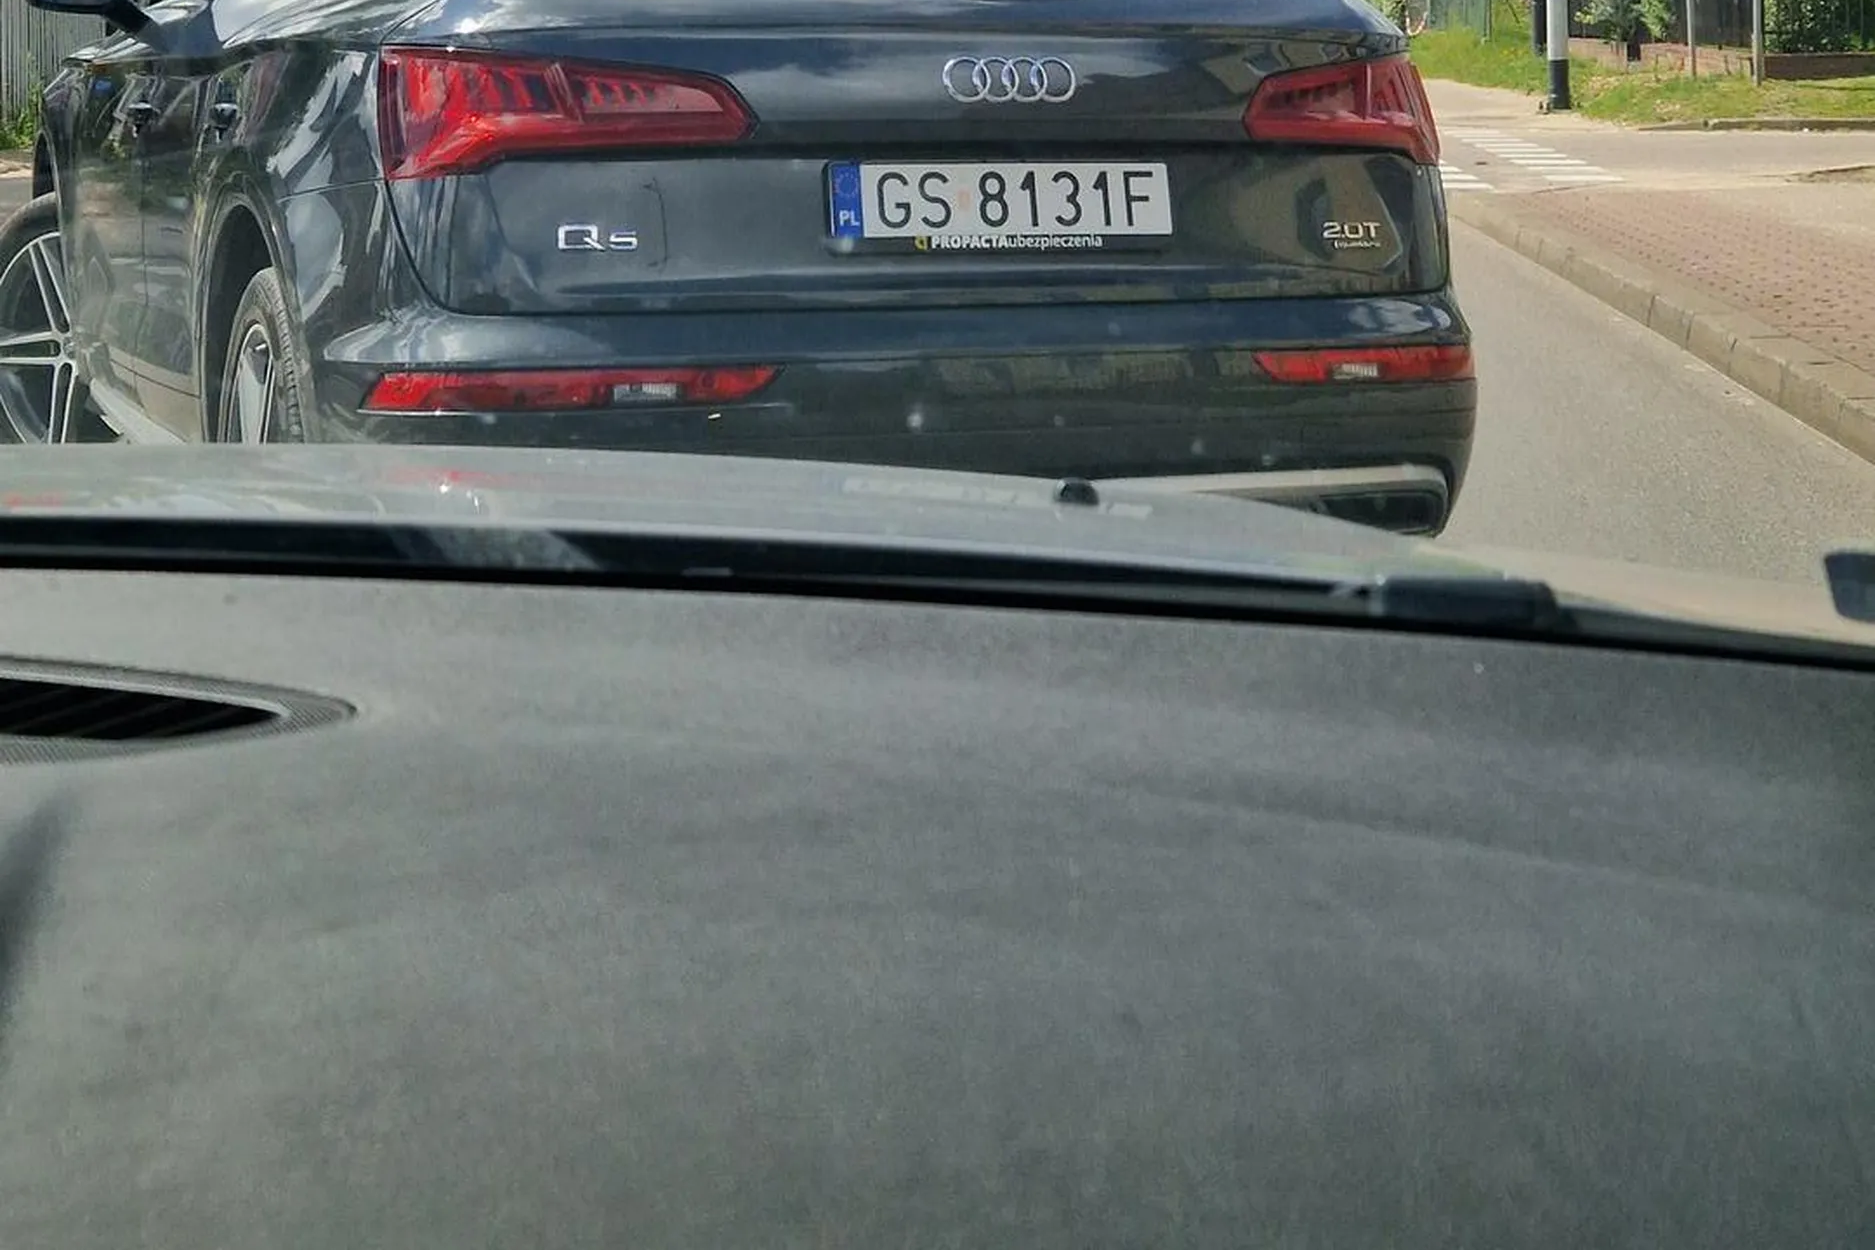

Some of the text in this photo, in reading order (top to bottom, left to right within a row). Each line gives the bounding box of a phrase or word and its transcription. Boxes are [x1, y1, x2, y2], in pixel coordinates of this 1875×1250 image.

[877, 170, 1154, 229] GS 8131F
[839, 210, 860, 226] PL
[557, 225, 638, 250] Q5
